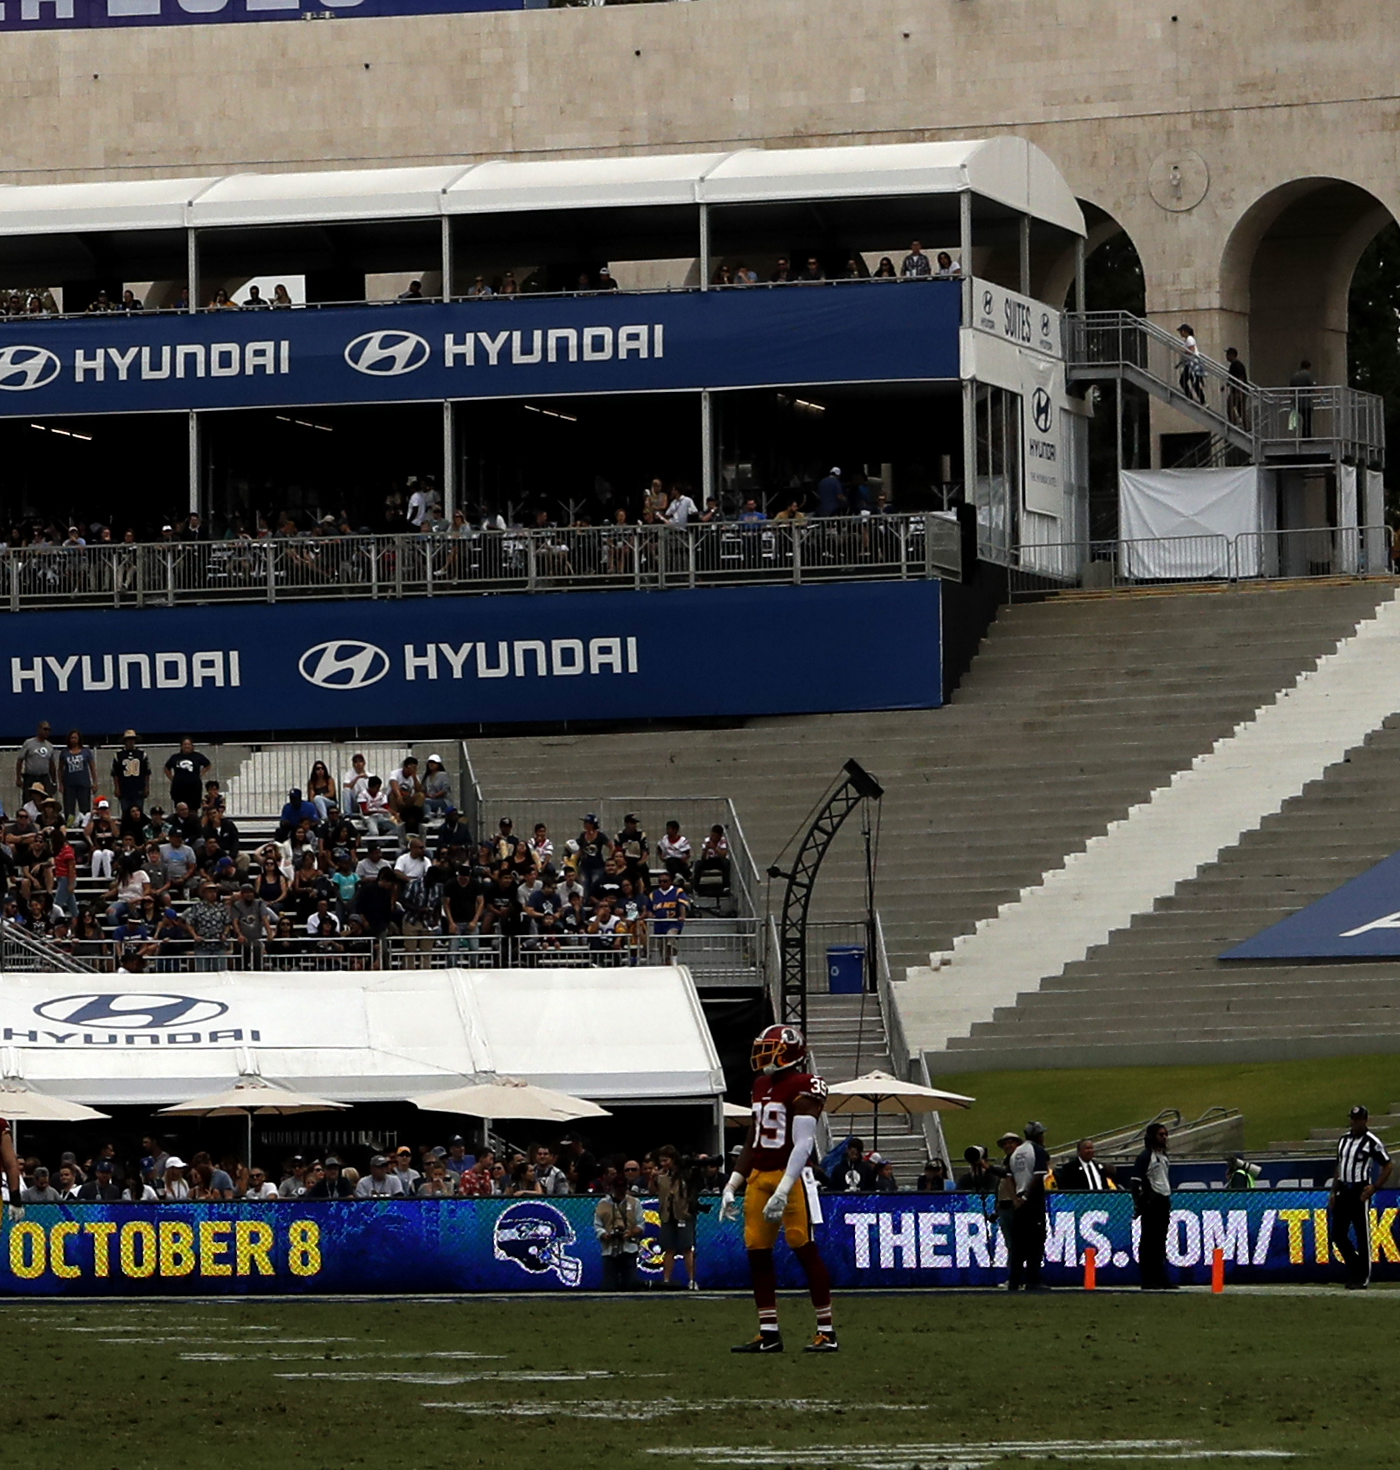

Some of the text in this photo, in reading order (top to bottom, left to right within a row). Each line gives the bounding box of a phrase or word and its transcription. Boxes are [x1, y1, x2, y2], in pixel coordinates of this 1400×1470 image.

[1004, 297, 1032, 344] SUITES
[73, 338, 292, 384] HYUNDAI
[443, 323, 665, 368] HYUNDAI
[10, 649, 241, 694] HYUNDAI
[403, 635, 640, 682] HYUNDAI
[3, 1027, 262, 1046] HYUNDAI
[8, 1219, 322, 1279] OCTOBER 8
